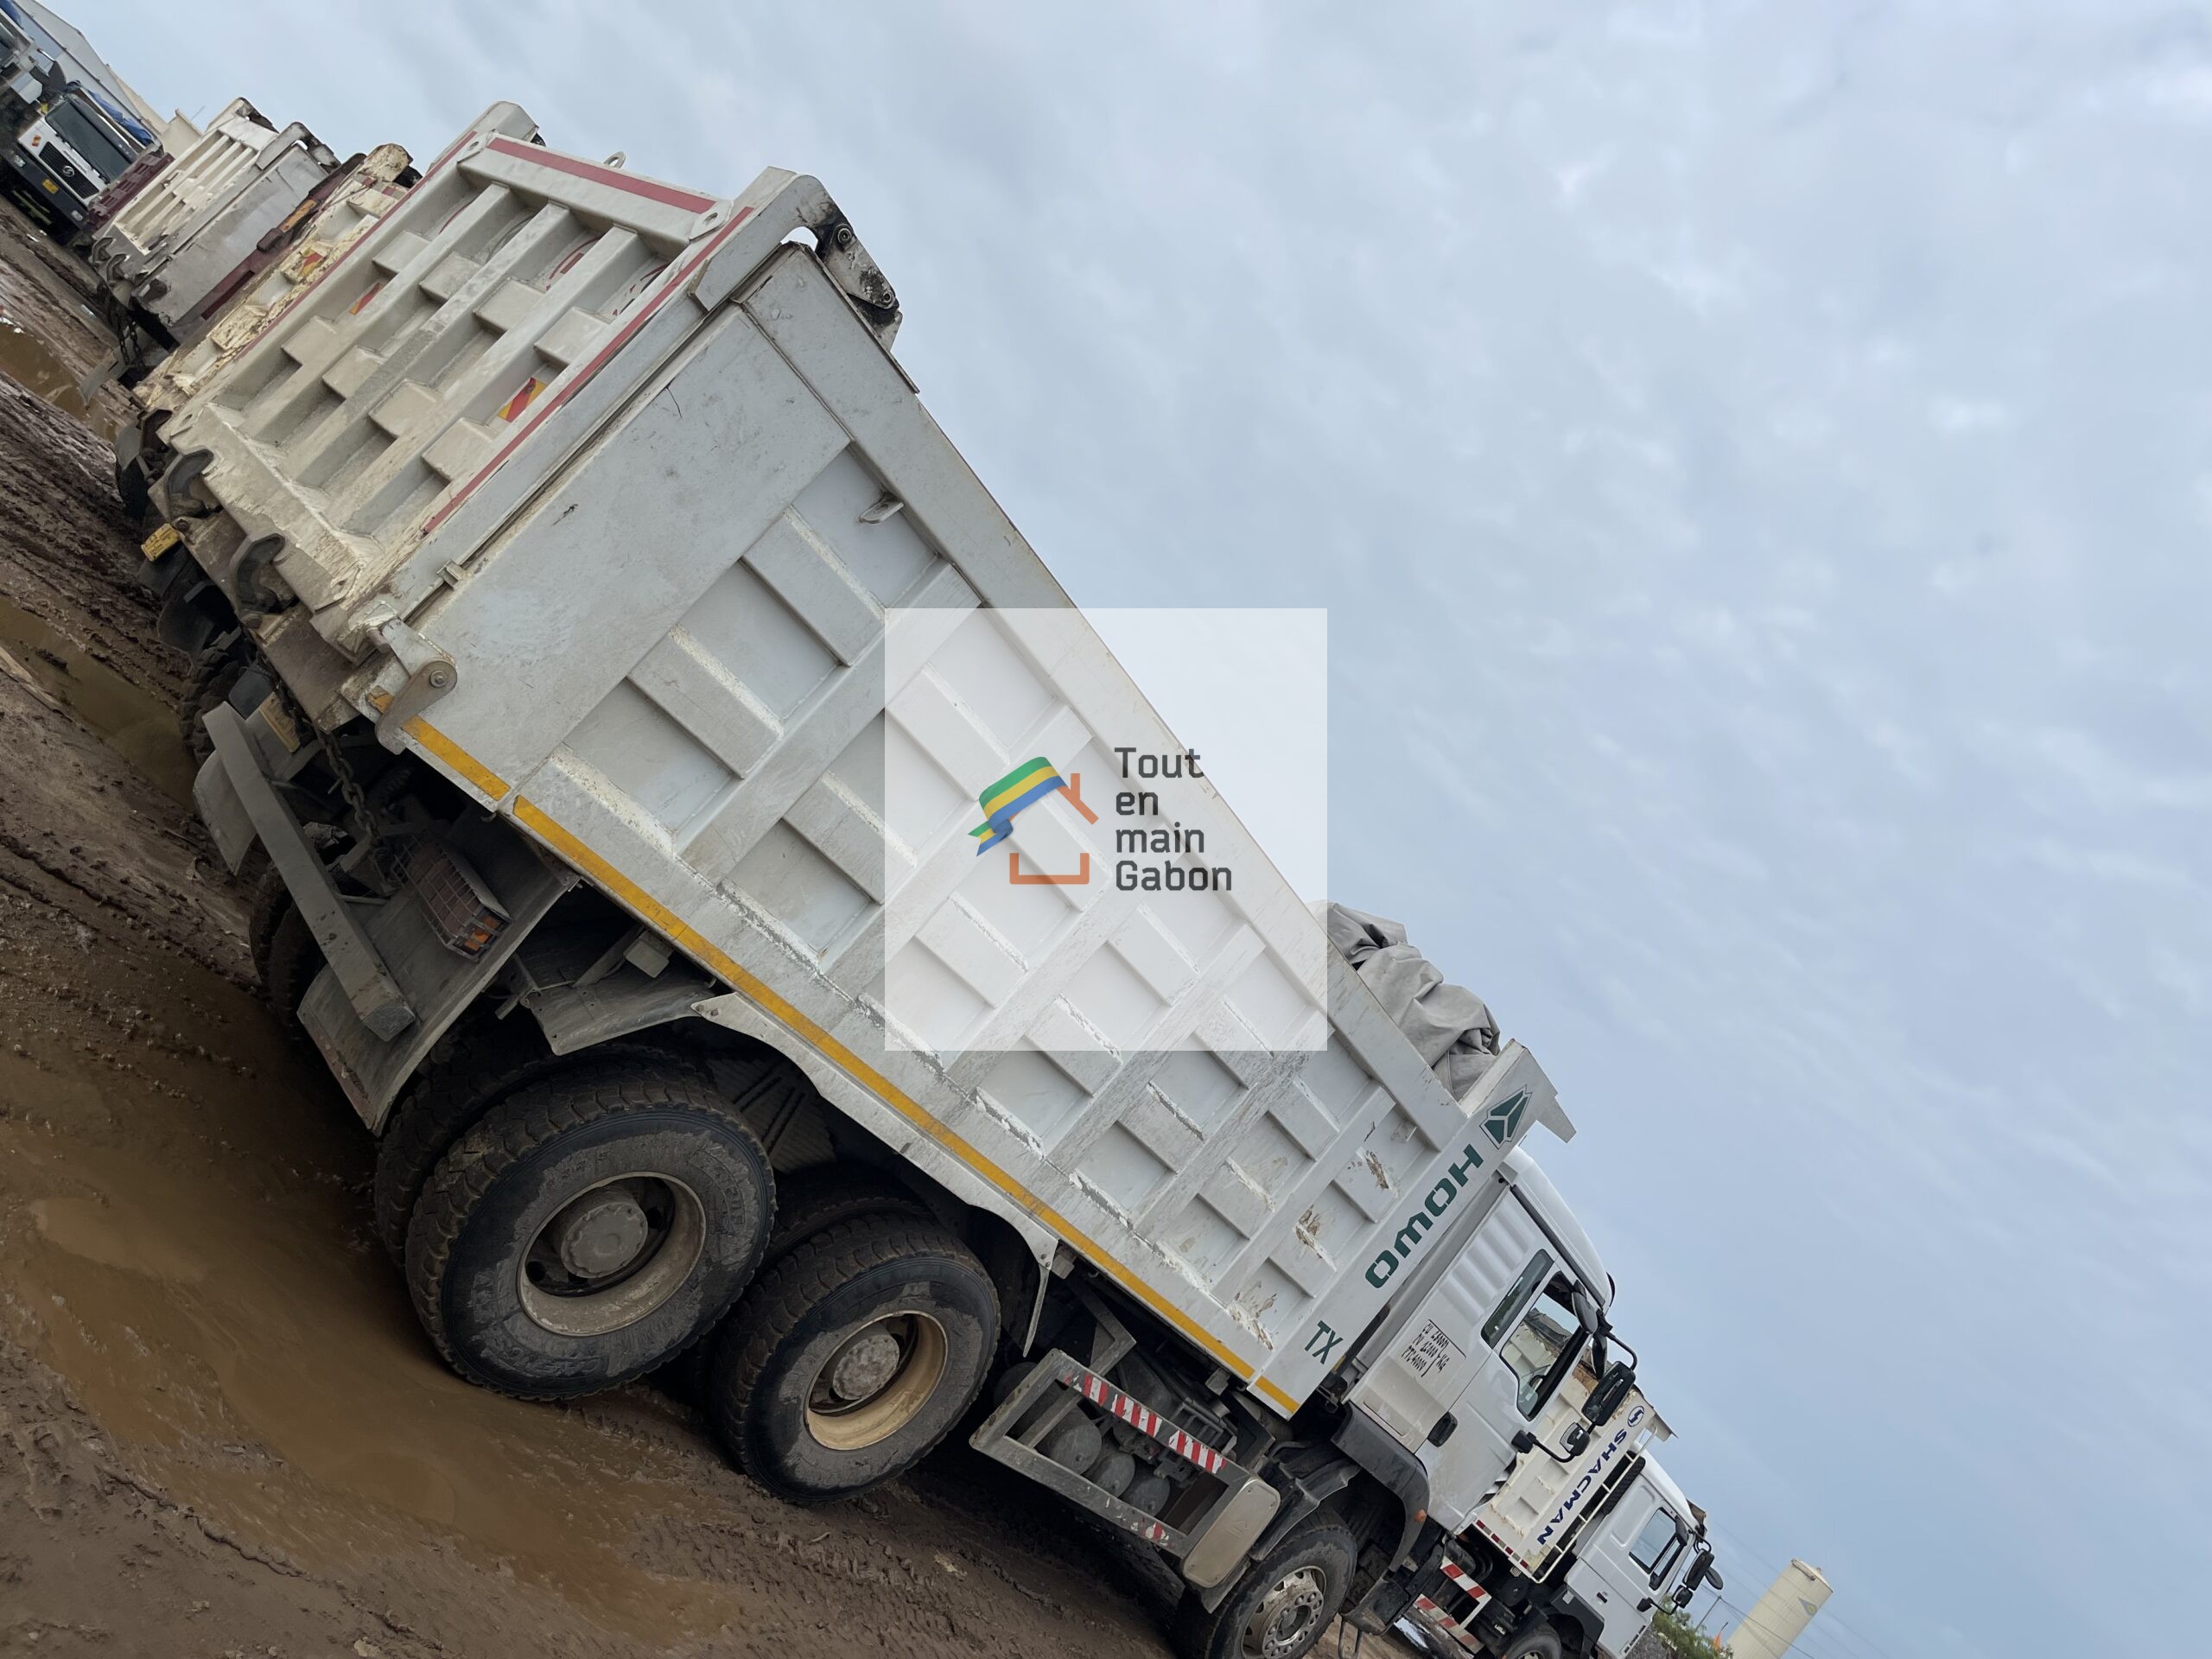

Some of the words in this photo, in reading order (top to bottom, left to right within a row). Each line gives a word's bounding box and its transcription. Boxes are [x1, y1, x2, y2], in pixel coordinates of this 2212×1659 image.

[1365, 1143, 1484, 1289] HOWO
[1304, 1319, 1344, 1365] TX
[1537, 1428, 1628, 1545] SHACMAN
